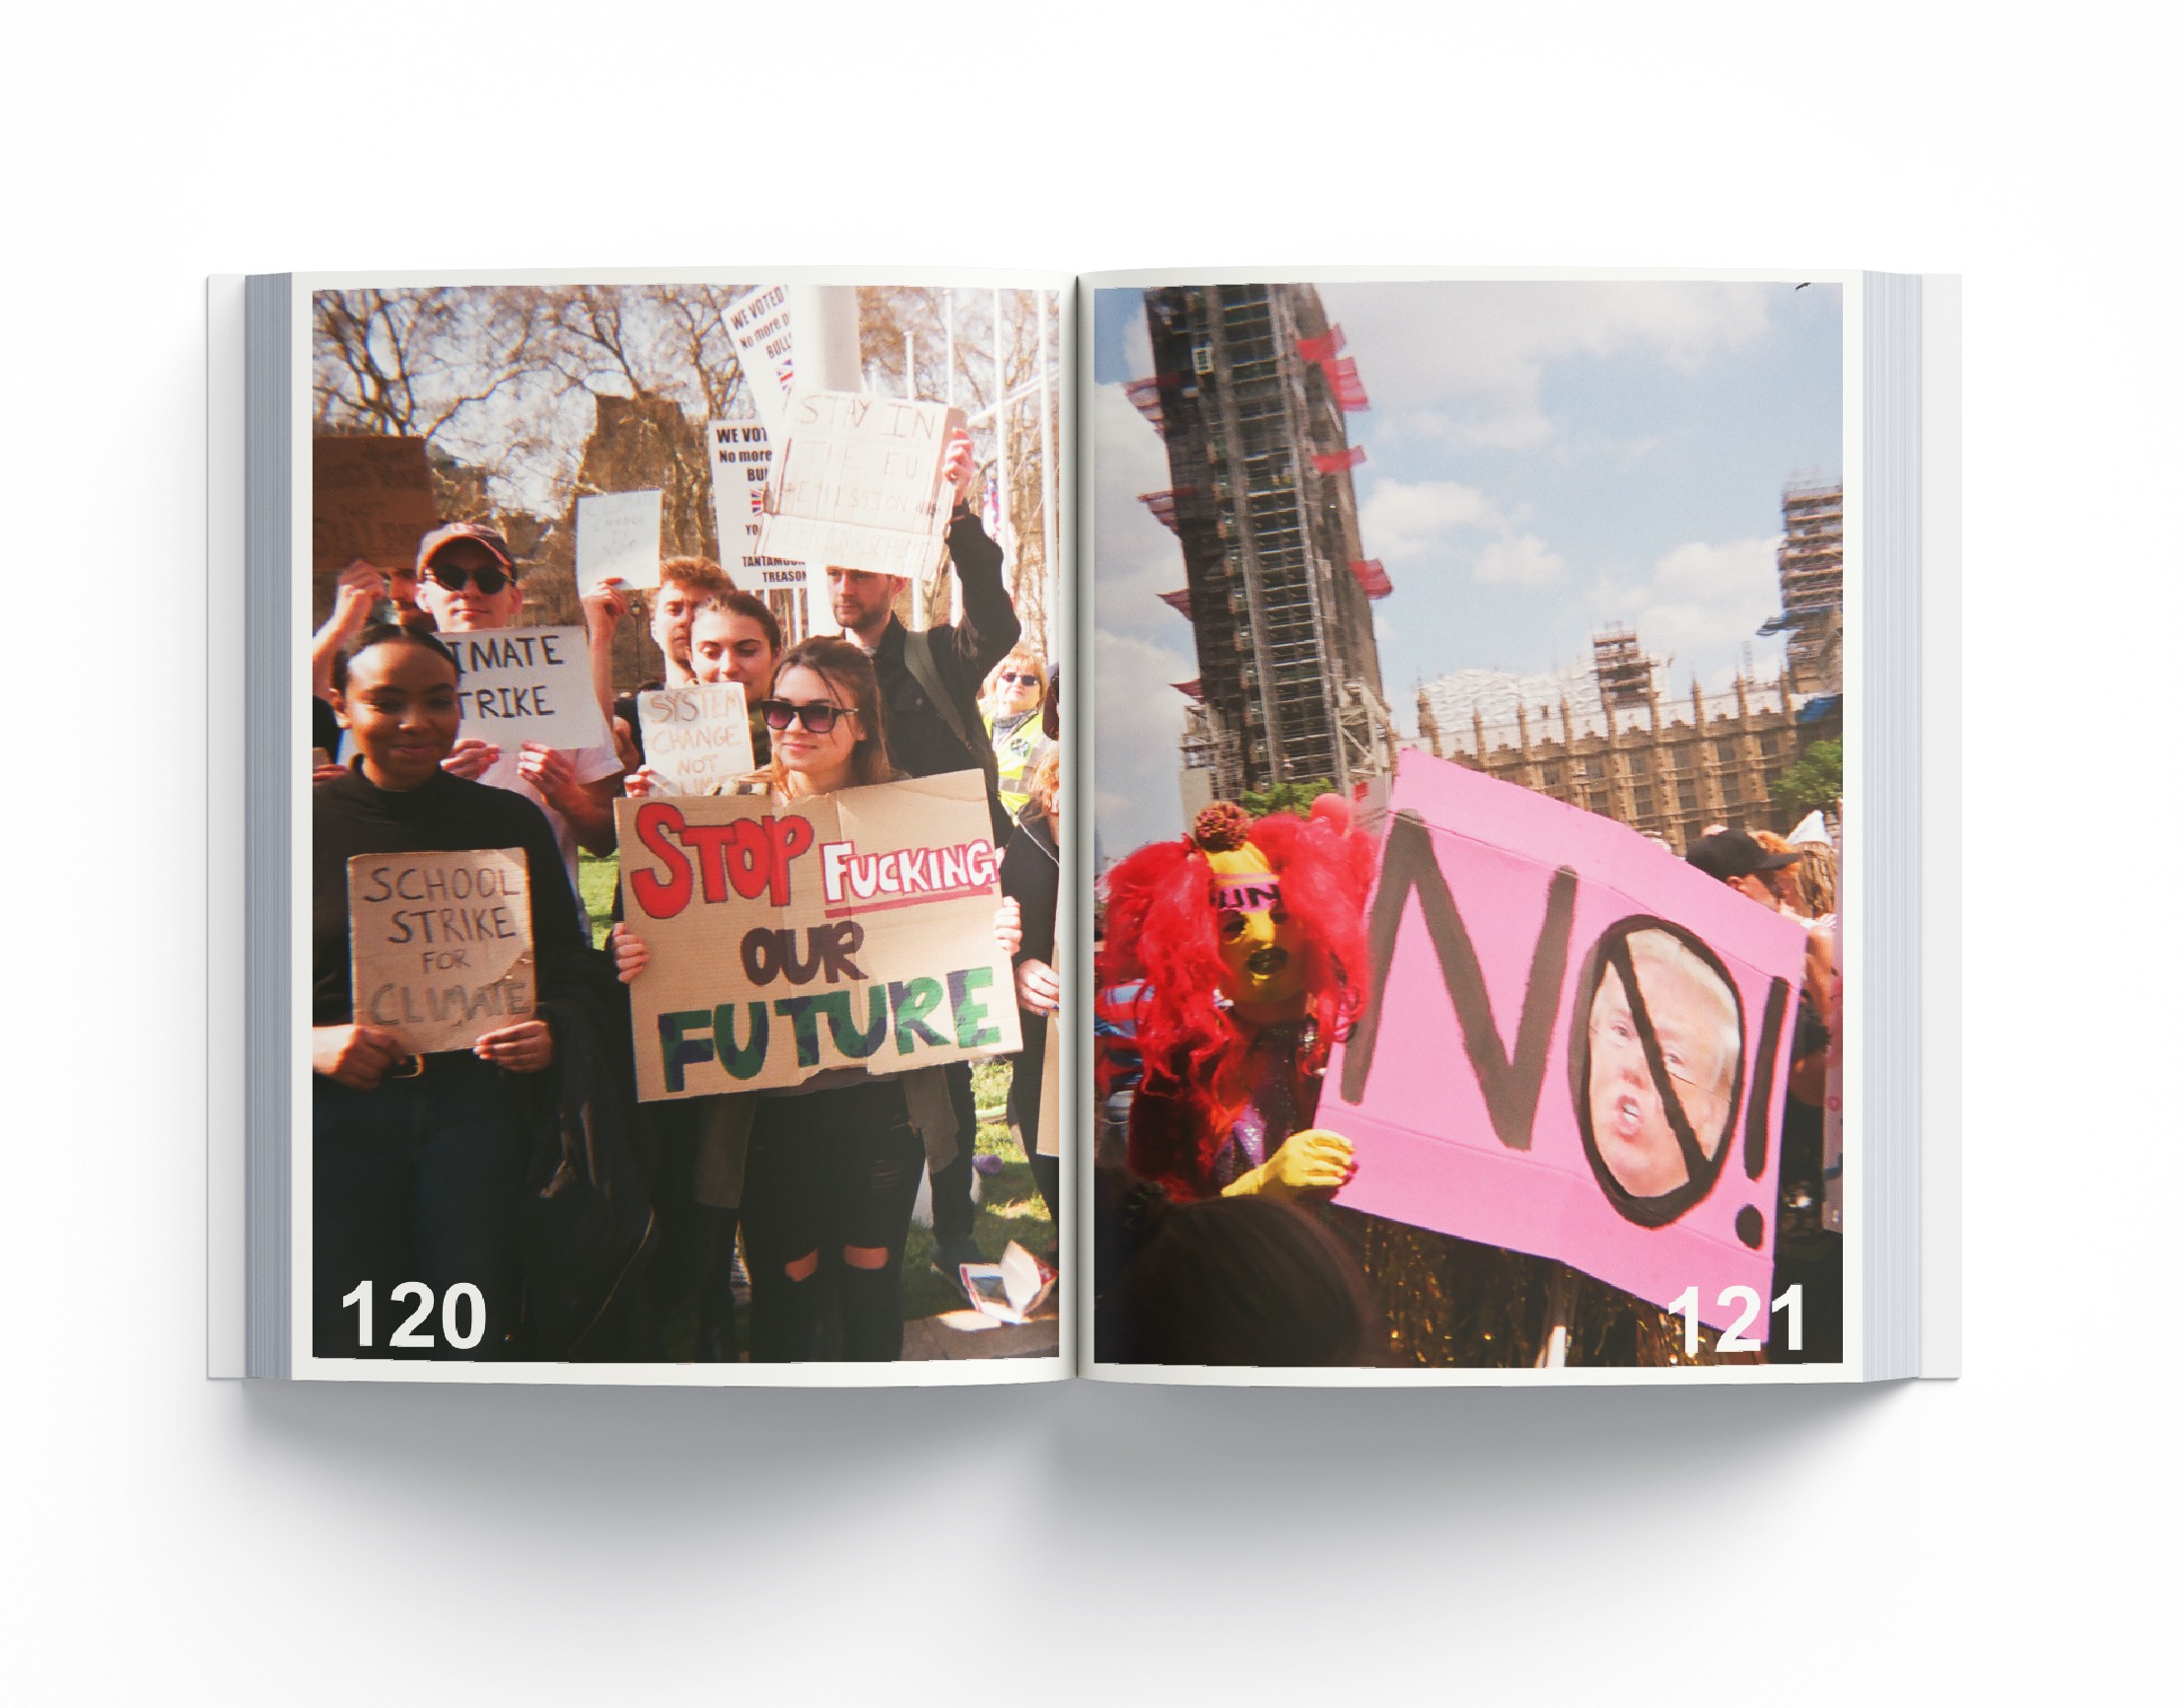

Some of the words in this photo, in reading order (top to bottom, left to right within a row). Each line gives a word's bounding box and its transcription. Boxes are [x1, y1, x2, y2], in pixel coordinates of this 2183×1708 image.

[730, 308, 749, 330] WE
[747, 286, 785, 320] VOTED
[739, 335, 754, 350] No
[753, 318, 782, 342] more
[717, 427, 739, 444] WE
[798, 394, 873, 428] STAY
[880, 402, 936, 441] IN
[719, 450, 737, 463] No
[739, 450, 773, 463] more
[747, 467, 767, 482] BU
[883, 451, 918, 479] EU
[650, 689, 745, 725] SYSTEM
[652, 725, 742, 754] CHANGE
[677, 753, 719, 775] NOT
[630, 801, 814, 919] STOP
[819, 839, 999, 905] FUCKING
[364, 867, 521, 902] SCHOOL
[387, 906, 516, 944] STRIKE
[421, 949, 471, 974] FOR
[740, 920, 870, 985] OUR
[370, 979, 531, 1026] CLIMATE
[658, 965, 1003, 1094] FUTURE
[342, 1280, 486, 1350] 120
[1667, 1284, 1803, 1355] 121
